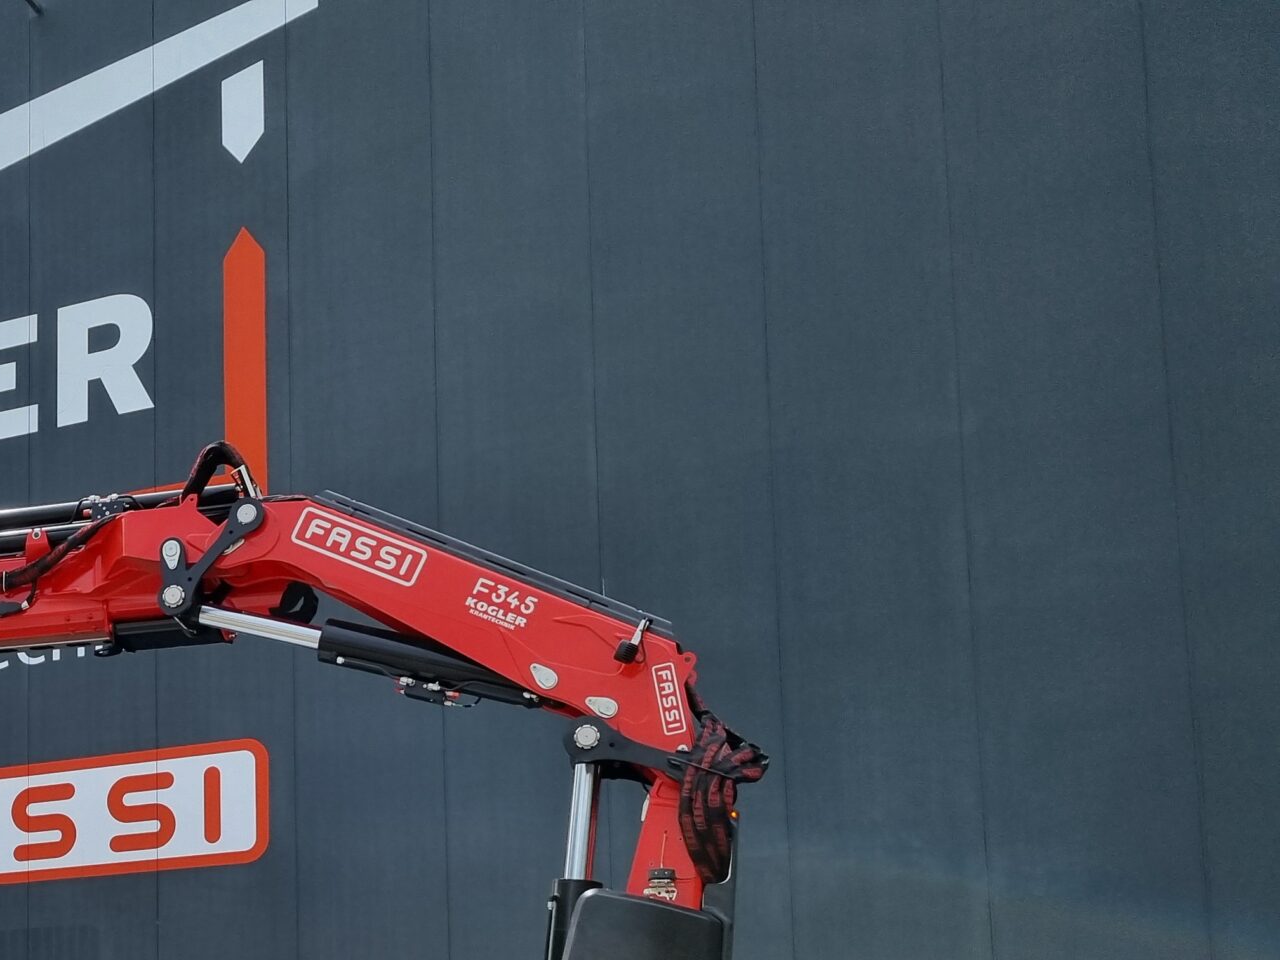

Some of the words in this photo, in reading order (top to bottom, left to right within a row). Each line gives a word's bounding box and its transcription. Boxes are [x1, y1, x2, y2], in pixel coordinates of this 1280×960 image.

[303, 518, 413, 577] FASSI
[465, 596, 527, 628] KOGLER
[472, 577, 539, 615] F345
[656, 668, 681, 730] FASSI
